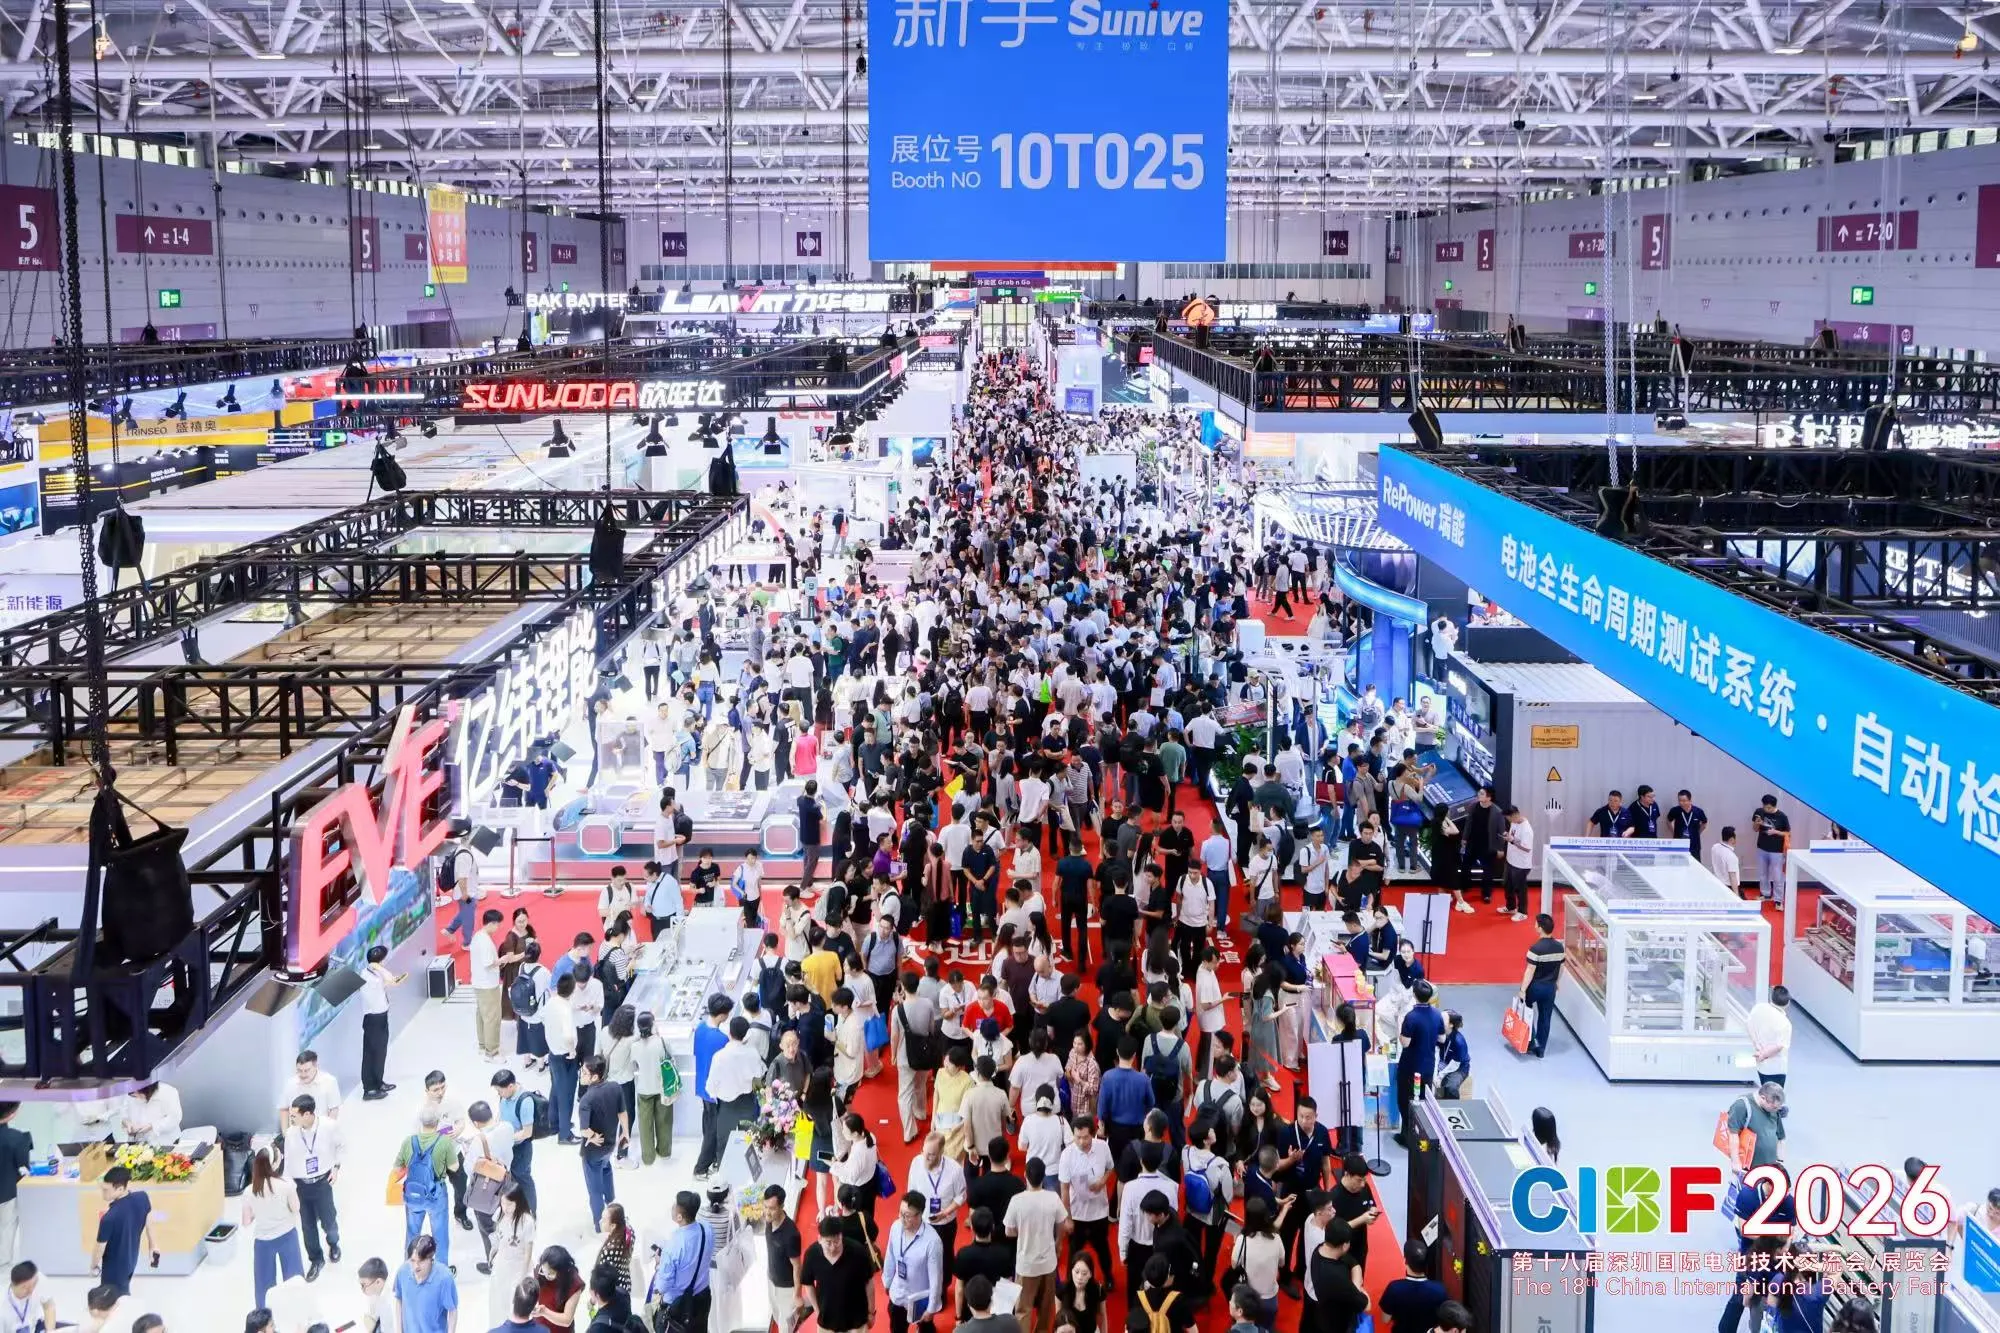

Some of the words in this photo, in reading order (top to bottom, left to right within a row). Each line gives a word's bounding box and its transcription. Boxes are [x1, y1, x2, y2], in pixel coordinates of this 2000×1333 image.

[1068, 0, 1203, 36] Sunive
[891, 134, 983, 164] 展位号
[991, 132, 1205, 190] 10T025
[891, 171, 945, 189] Booth
[951, 171, 981, 189] NO
[19, 204, 39, 250] 5
[172, 226, 190, 246] 1-4
[1651, 225, 1661, 257] 5
[362, 228, 371, 259] 5
[526, 292, 563, 308] BAK
[462, 382, 639, 410] SUNWODA
[638, 379, 727, 409] 欣旺达
[1382, 475, 1437, 530] RePower
[1438, 502, 1466, 549] 瑞能
[296, 703, 451, 972] EVE
